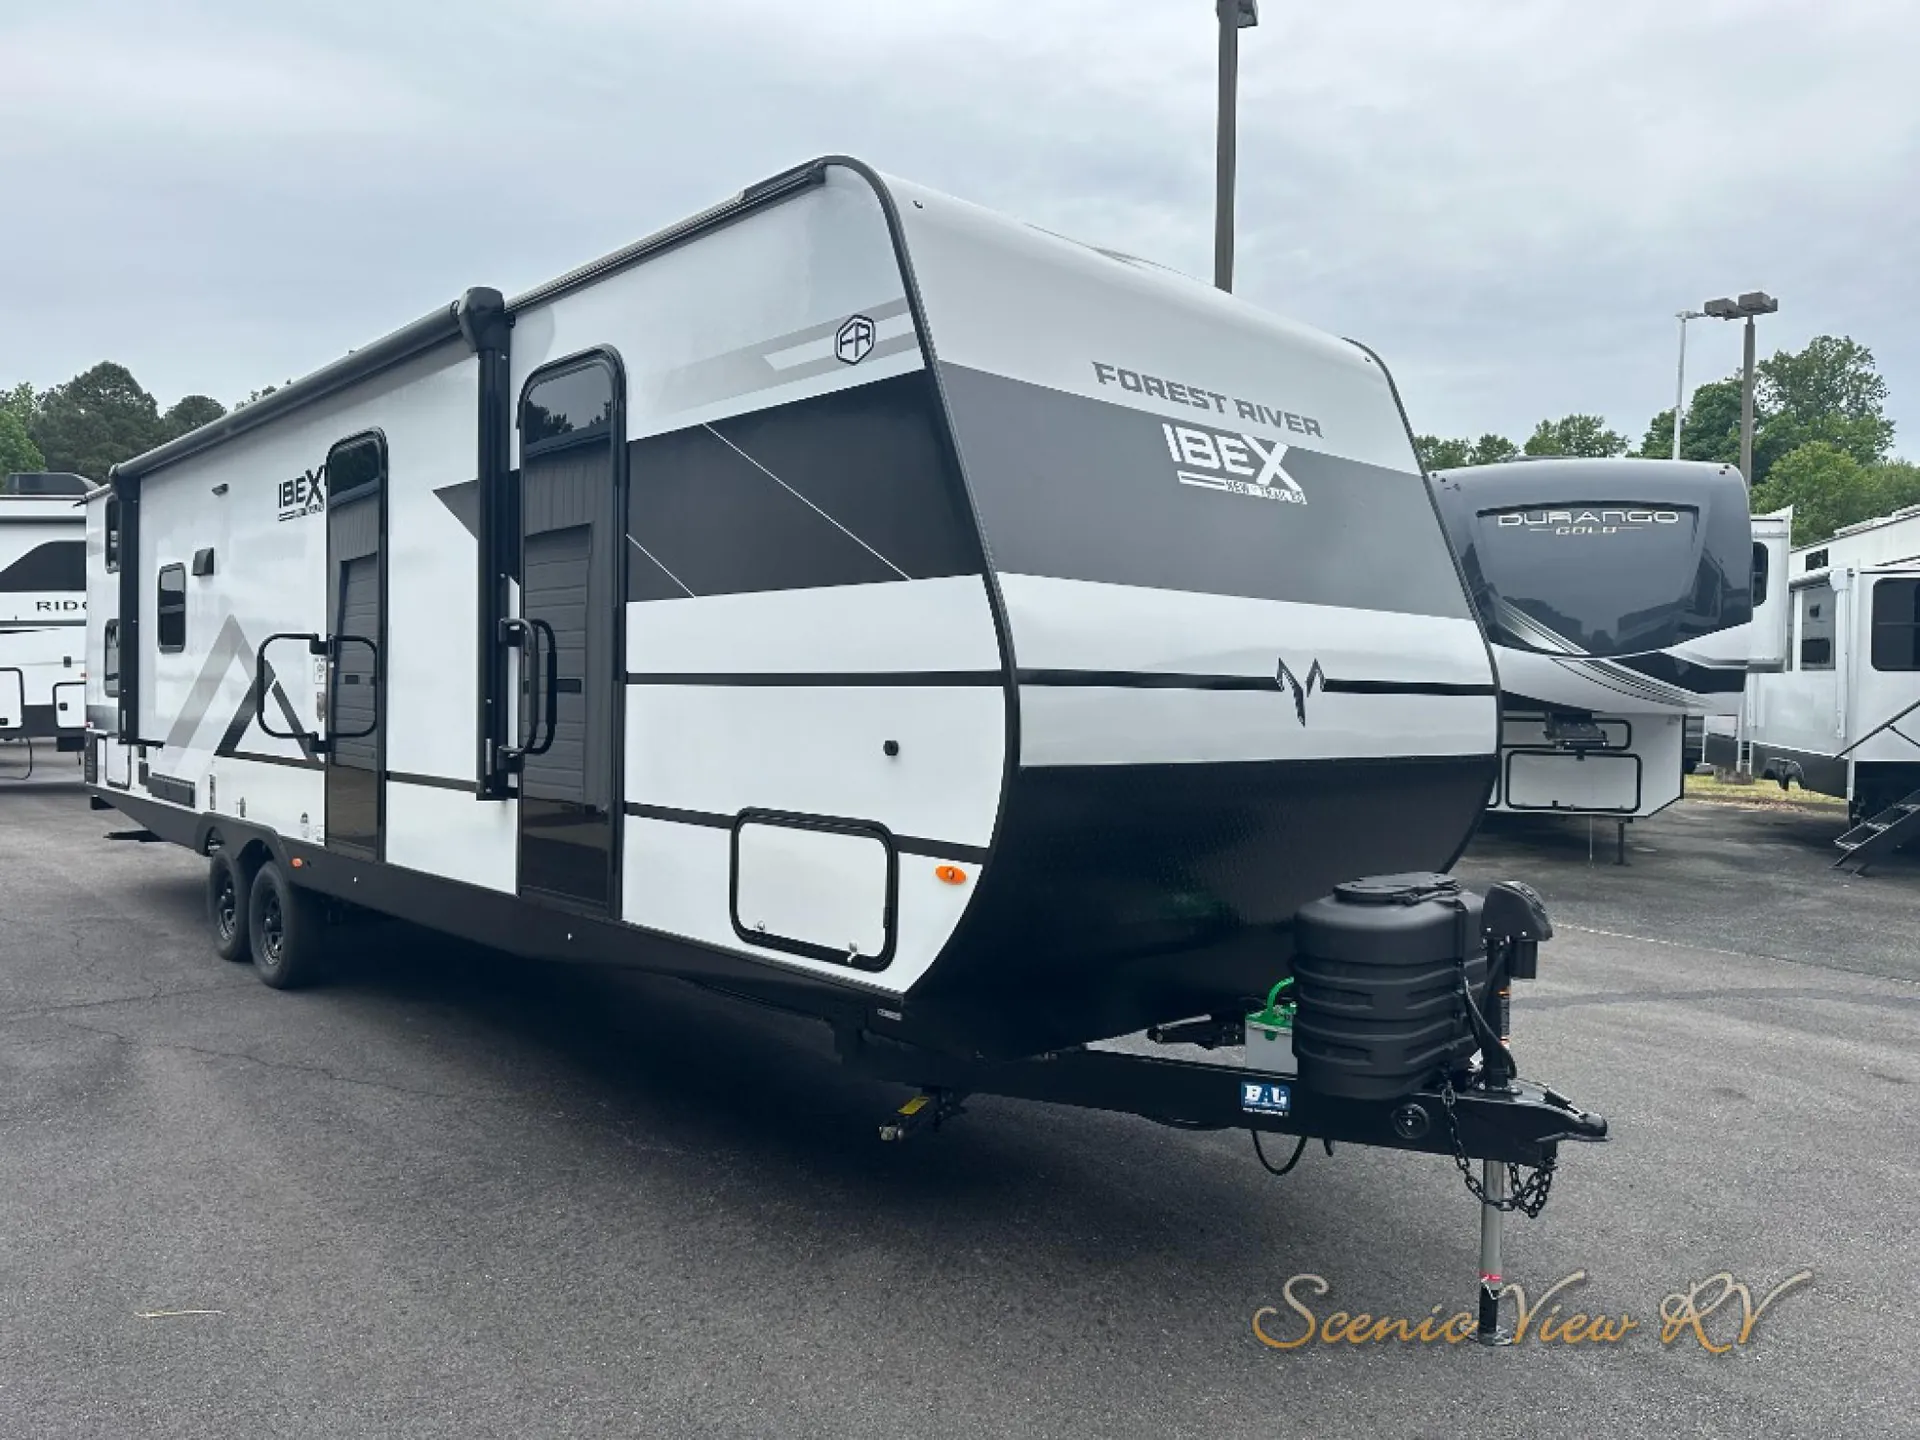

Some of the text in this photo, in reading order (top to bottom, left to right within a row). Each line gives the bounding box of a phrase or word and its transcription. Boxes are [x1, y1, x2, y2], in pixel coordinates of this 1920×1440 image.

[1091, 360, 1324, 439] FOREST RIVER
[1162, 422, 1307, 504] IBEX
[278, 465, 326, 509] IBEX
[1498, 510, 1679, 527] DURANGO
[1555, 525, 1617, 536] GOLD
